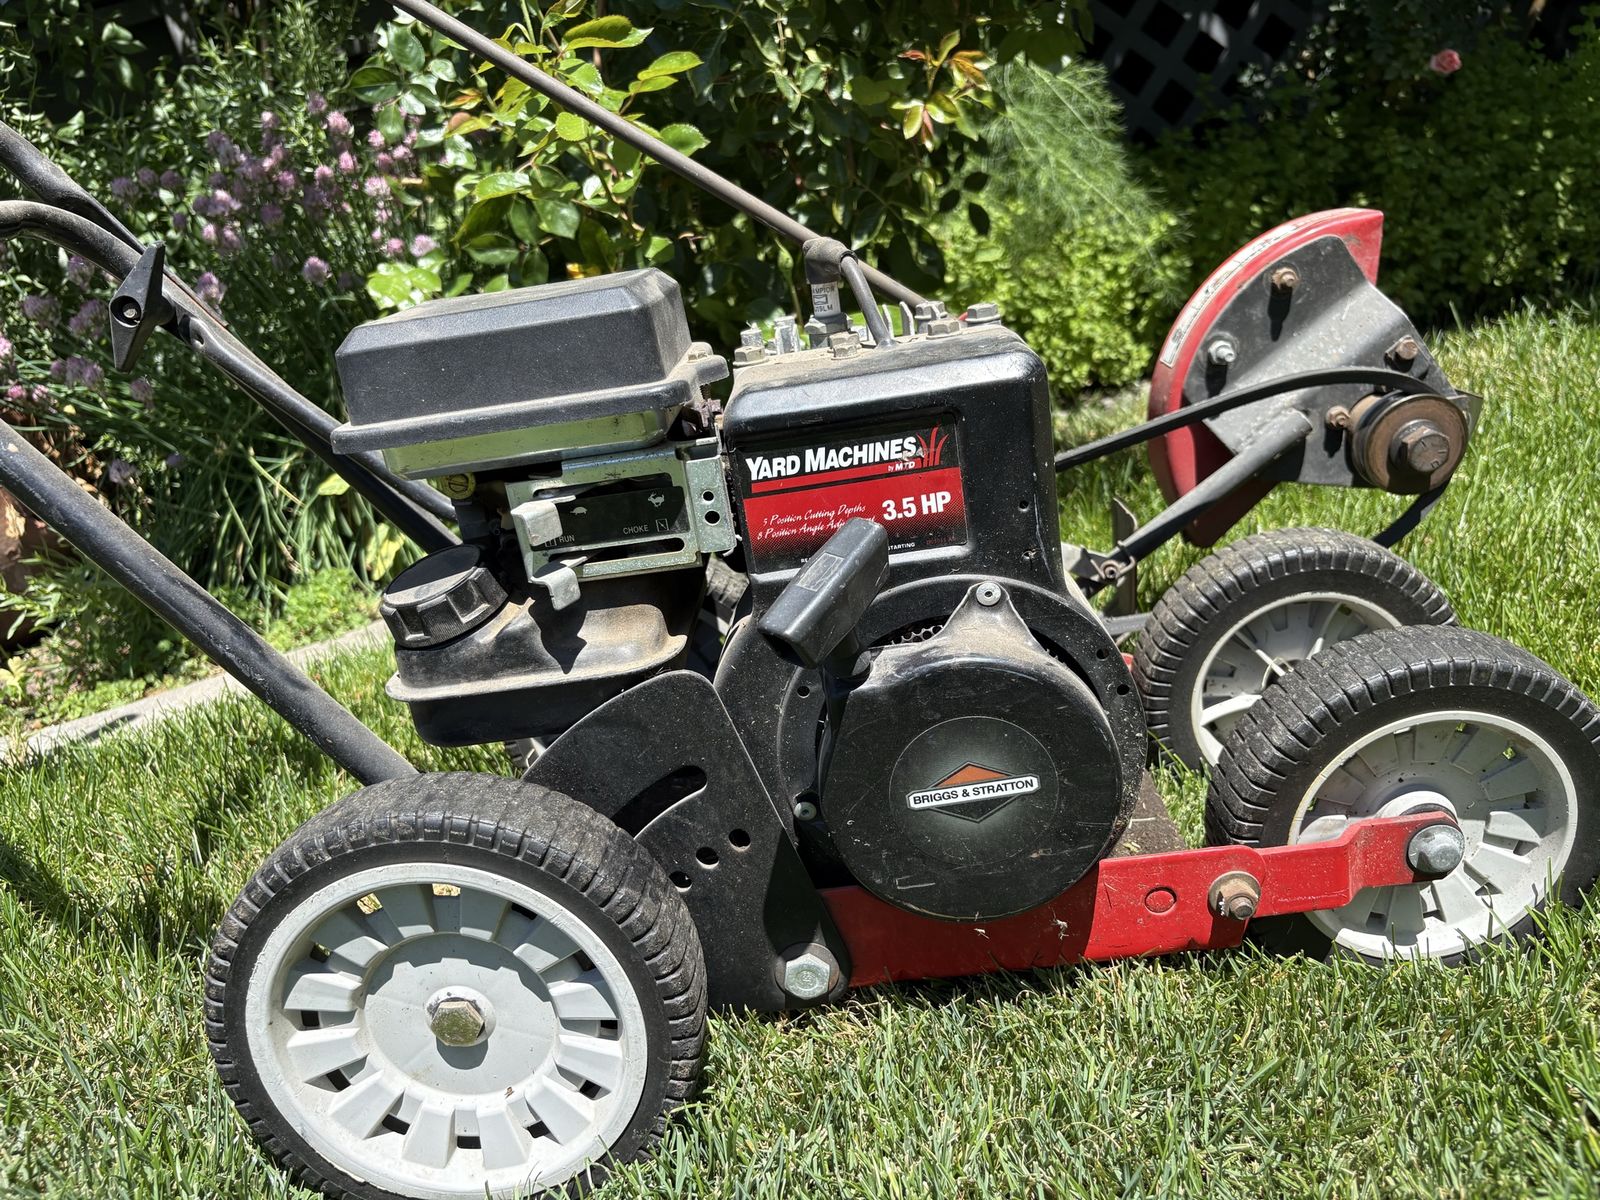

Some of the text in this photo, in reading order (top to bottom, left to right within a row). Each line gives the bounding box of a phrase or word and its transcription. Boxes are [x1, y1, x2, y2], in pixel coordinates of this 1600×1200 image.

[745, 436, 917, 481] YARD MACHINES
[895, 461, 915, 471] MTD
[763, 502, 866, 526] 5 Position Cutting Depths
[882, 491, 952, 521] 3.5 HP
[559, 534, 575, 543] RUN
[622, 525, 649, 535] CHOKE
[757, 532, 763, 540] 8
[765, 527, 797, 539] Position
[799, 522, 824, 536] Angle
[913, 779, 1034, 805] BRIGGS & STRATTON
